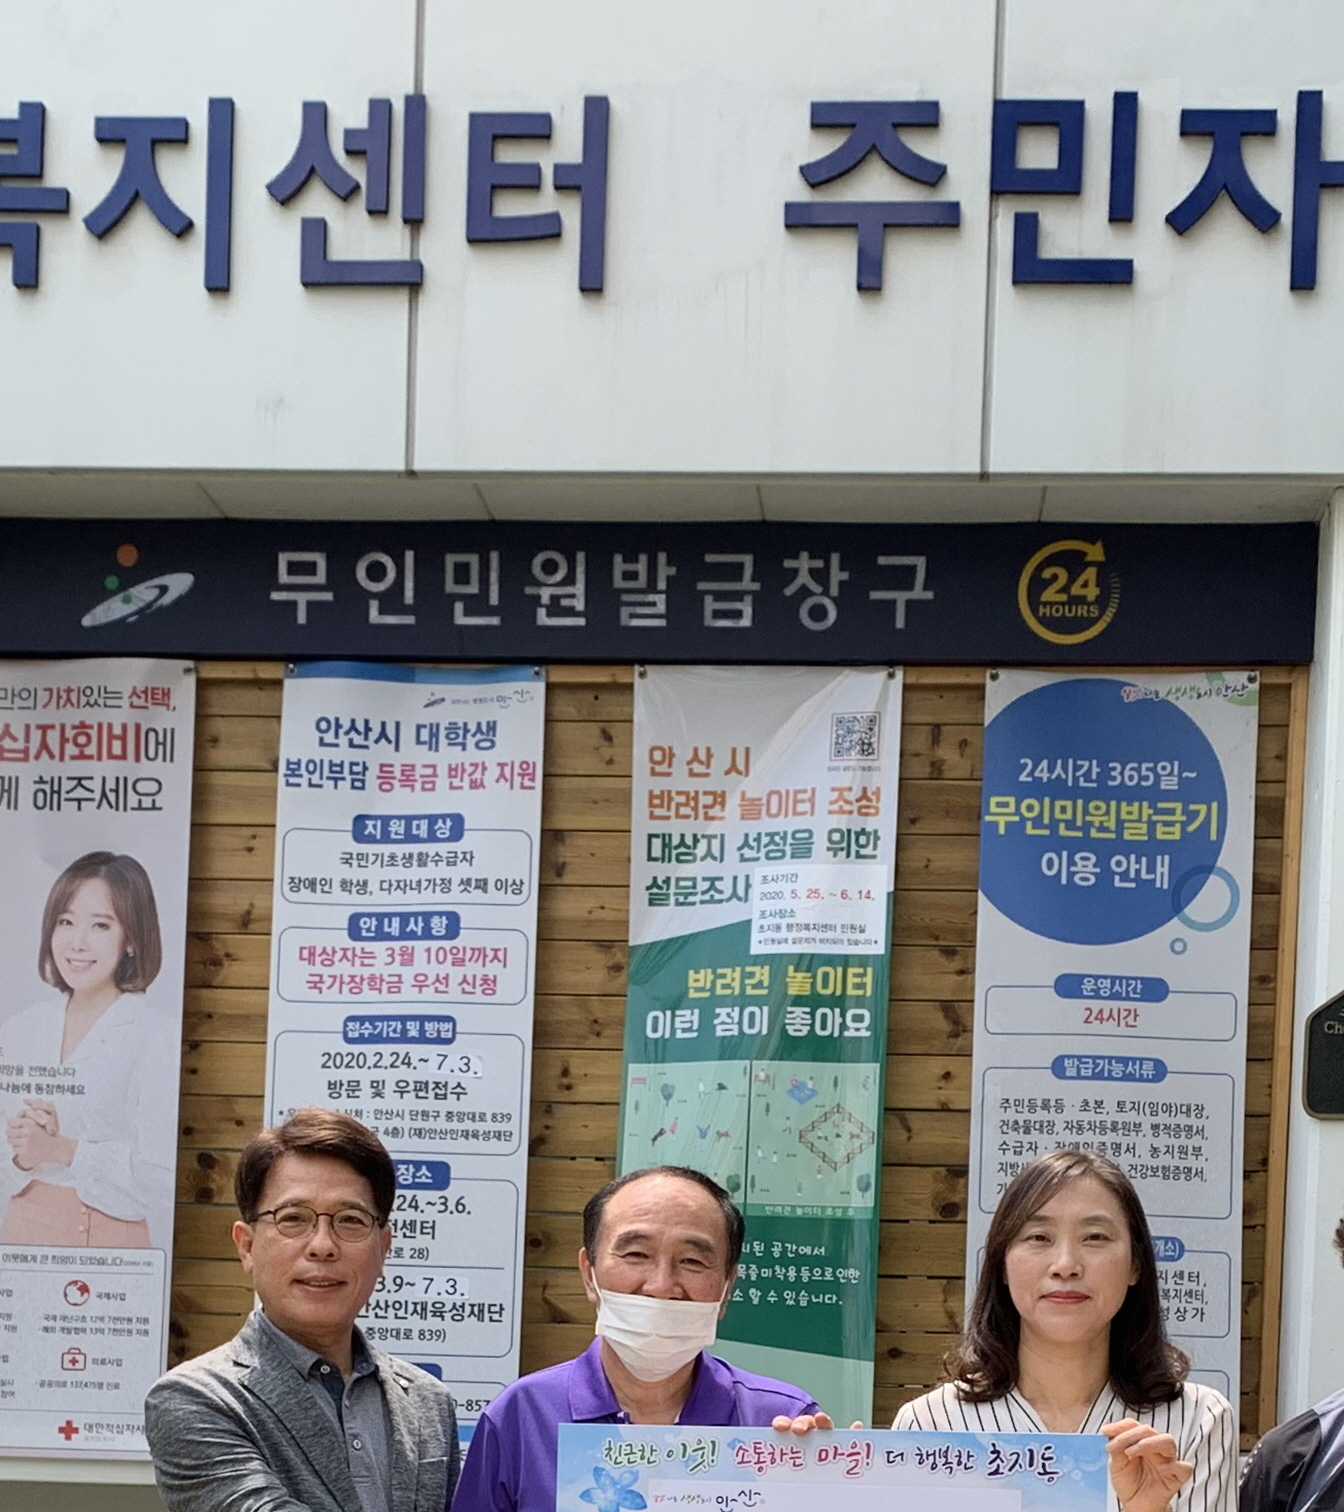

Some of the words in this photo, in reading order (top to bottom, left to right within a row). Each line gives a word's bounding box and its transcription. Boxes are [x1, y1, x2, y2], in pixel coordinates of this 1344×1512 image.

[269, 549, 935, 630] 무인민원발급창구
[1040, 566, 1101, 604] 24
[1038, 604, 1099, 618] HOURS
[42, 685, 123, 710] 가치있는
[128, 686, 176, 711] 선택,
[315, 716, 401, 752] 안산시
[415, 720, 497, 752] 대학생
[284, 758, 368, 790] 본인부담
[376, 763, 438, 793] 등록금
[448, 761, 487, 790] 반값
[495, 760, 537, 790] 지원
[1018, 758, 1100, 788] 24시간
[1108, 761, 1198, 790] 365일~
[33, 775, 163, 812] 해주세요
[648, 789, 726, 820] 반려견
[738, 787, 816, 820] 놀이터
[827, 786, 881, 816] 조성
[985, 796, 1219, 841] 무인민원발급기
[647, 833, 725, 864] 대상지
[737, 829, 815, 862] 선정을
[826, 828, 880, 859] 위한
[340, 850, 474, 869] 국민기초생활수급자
[1041, 851, 1101, 886] 이용
[1110, 854, 1170, 889] 안내
[288, 876, 332, 895] 장애인
[339, 878, 373, 896] 학생,
[379, 877, 452, 895] 다자녀가정
[458, 878, 488, 894] 셋째
[495, 877, 524, 895] 이상
[761, 873, 799, 883] 조사기간
[646, 874, 752, 906] 설문조사
[760, 891, 786, 900] 2020.
[759, 909, 796, 920] 조사장소
[758, 925, 782, 934] 초지동
[786, 923, 836, 934] 행정복지센터
[841, 923, 866, 934] 민원실
[299, 945, 376, 968] 대상자는
[384, 945, 415, 967] 3월
[425, 946, 507, 968] 10일까지
[306, 974, 404, 995] 국가장학금
[411, 973, 449, 994] 우선
[458, 974, 497, 996] 신청
[688, 965, 770, 998] 반려견
[786, 965, 873, 996] 놀이터
[1082, 978, 1143, 998] 운영시간
[646, 1008, 700, 1039] 이런
[714, 1006, 768, 1036] 점이
[785, 1007, 871, 1037] 좋아요
[1083, 1007, 1139, 1028] 24시간
[346, 1021, 401, 1038] 접수기간
[406, 1022, 419, 1038] 및
[424, 1022, 452, 1038] 방법
[1064, 1058, 1156, 1078] 발급가능서류
[328, 1080, 361, 1099] 방문
[370, 1080, 385, 1099] 및
[393, 1080, 468, 1100] 우편접수
[374, 1110, 405, 1122] 안산시
[409, 1110, 441, 1122] 단원구
[445, 1111, 487, 1123] 중앙대로
[491, 1112, 512, 1123] 839
[1079, 1099, 1109, 1115] 초본,
[1116, 1101, 1209, 1120] 토지(임야)대장,
[408, 1128, 513, 1142] (재)안산인재육성재단
[999, 1119, 1059, 1136] 건축물대장,
[1063, 1120, 1146, 1138] 자동차등록원부,
[1150, 1123, 1208, 1140] 병적증명서,
[998, 1141, 1038, 1156] 수급자
[1149, 1145, 1208, 1162] 농지원부,
[771, 1241, 826, 1258] 공간에서
[767, 1290, 778, 1303] 수
[784, 1290, 843, 1306] 있습니다.
[418, 1329, 446, 1343] 839)
[604, 1440, 656, 1466] 친근한
[667, 1439, 717, 1472] 이웃!
[735, 1440, 804, 1473] 소통하는
[817, 1439, 873, 1476] 마을!
[885, 1450, 904, 1465] 더
[916, 1444, 975, 1474] 행복한
[986, 1443, 1060, 1482] 초지동
